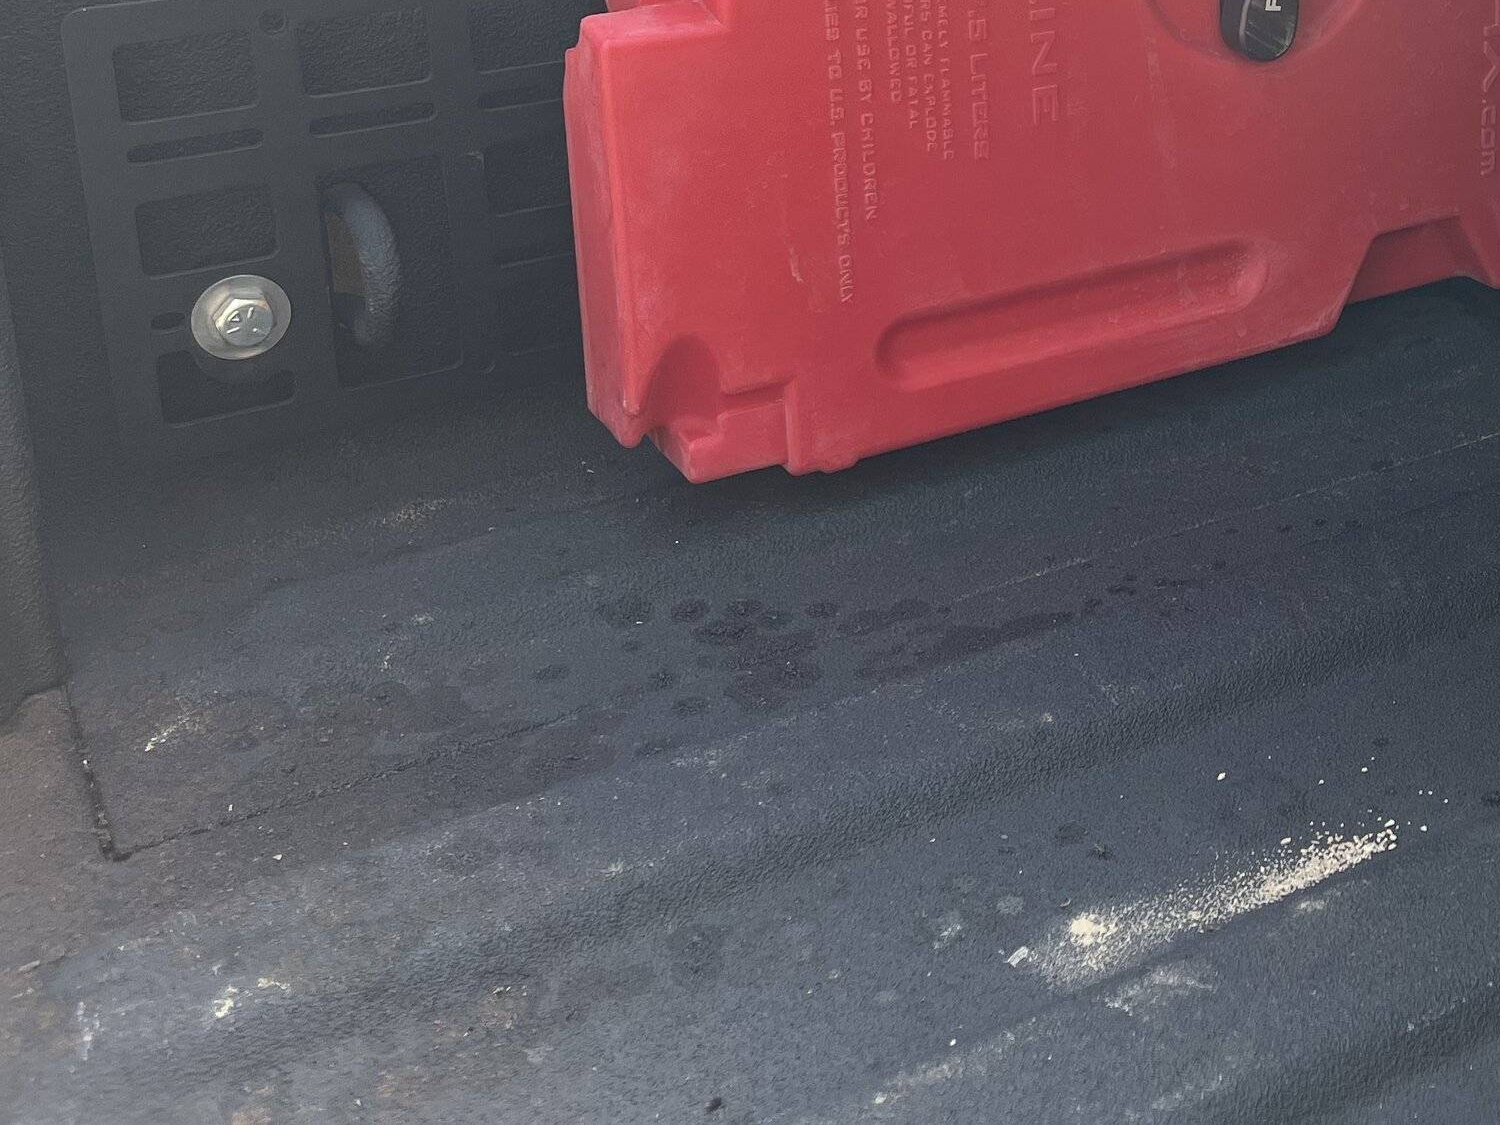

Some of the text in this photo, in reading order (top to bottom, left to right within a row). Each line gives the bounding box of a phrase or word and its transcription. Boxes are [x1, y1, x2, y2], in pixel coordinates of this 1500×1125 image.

[826, 52, 842, 80] TO
[855, 27, 871, 71] USE
[905, 44, 917, 68] OR
[921, 30, 934, 65] CAN
[830, 88, 845, 126] U.S.
[858, 79, 873, 103] BY
[908, 75, 920, 130] FATAL
[923, 74, 938, 152] EXPLODE
[939, 58, 953, 160] FLAMMABLE
[970, 52, 991, 161] LITERS
[831, 131, 850, 246] PRODUCTS
[860, 113, 878, 220] CHILDREN
[839, 255, 854, 305] ONLY
